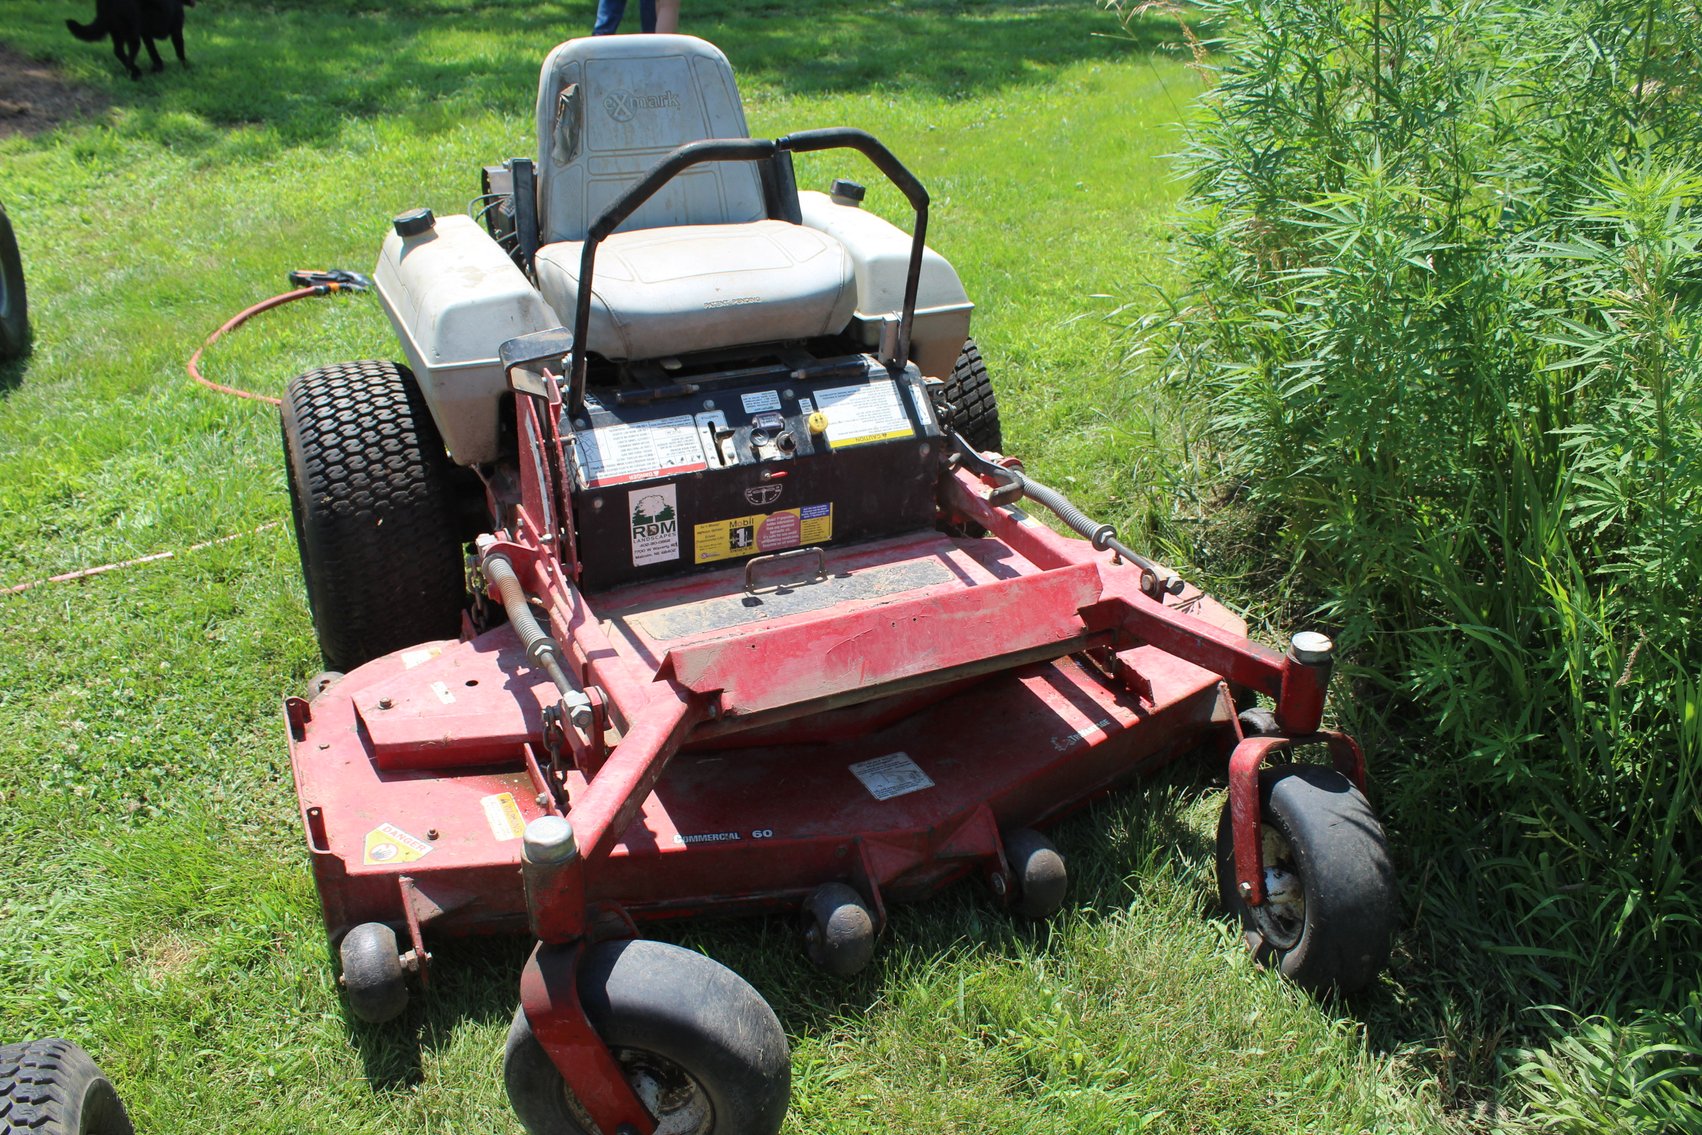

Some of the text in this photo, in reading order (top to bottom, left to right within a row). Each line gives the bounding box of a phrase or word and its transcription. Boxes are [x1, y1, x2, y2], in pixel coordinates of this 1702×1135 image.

[855, 433, 882, 442] CAUTION
[729, 517, 754, 528] Mobil
[633, 520, 676, 539] RDM
[633, 533, 677, 543] LANDSCAPES
[383, 825, 426, 852] DANGER
[673, 829, 773, 843] COMMERCIAL 60
